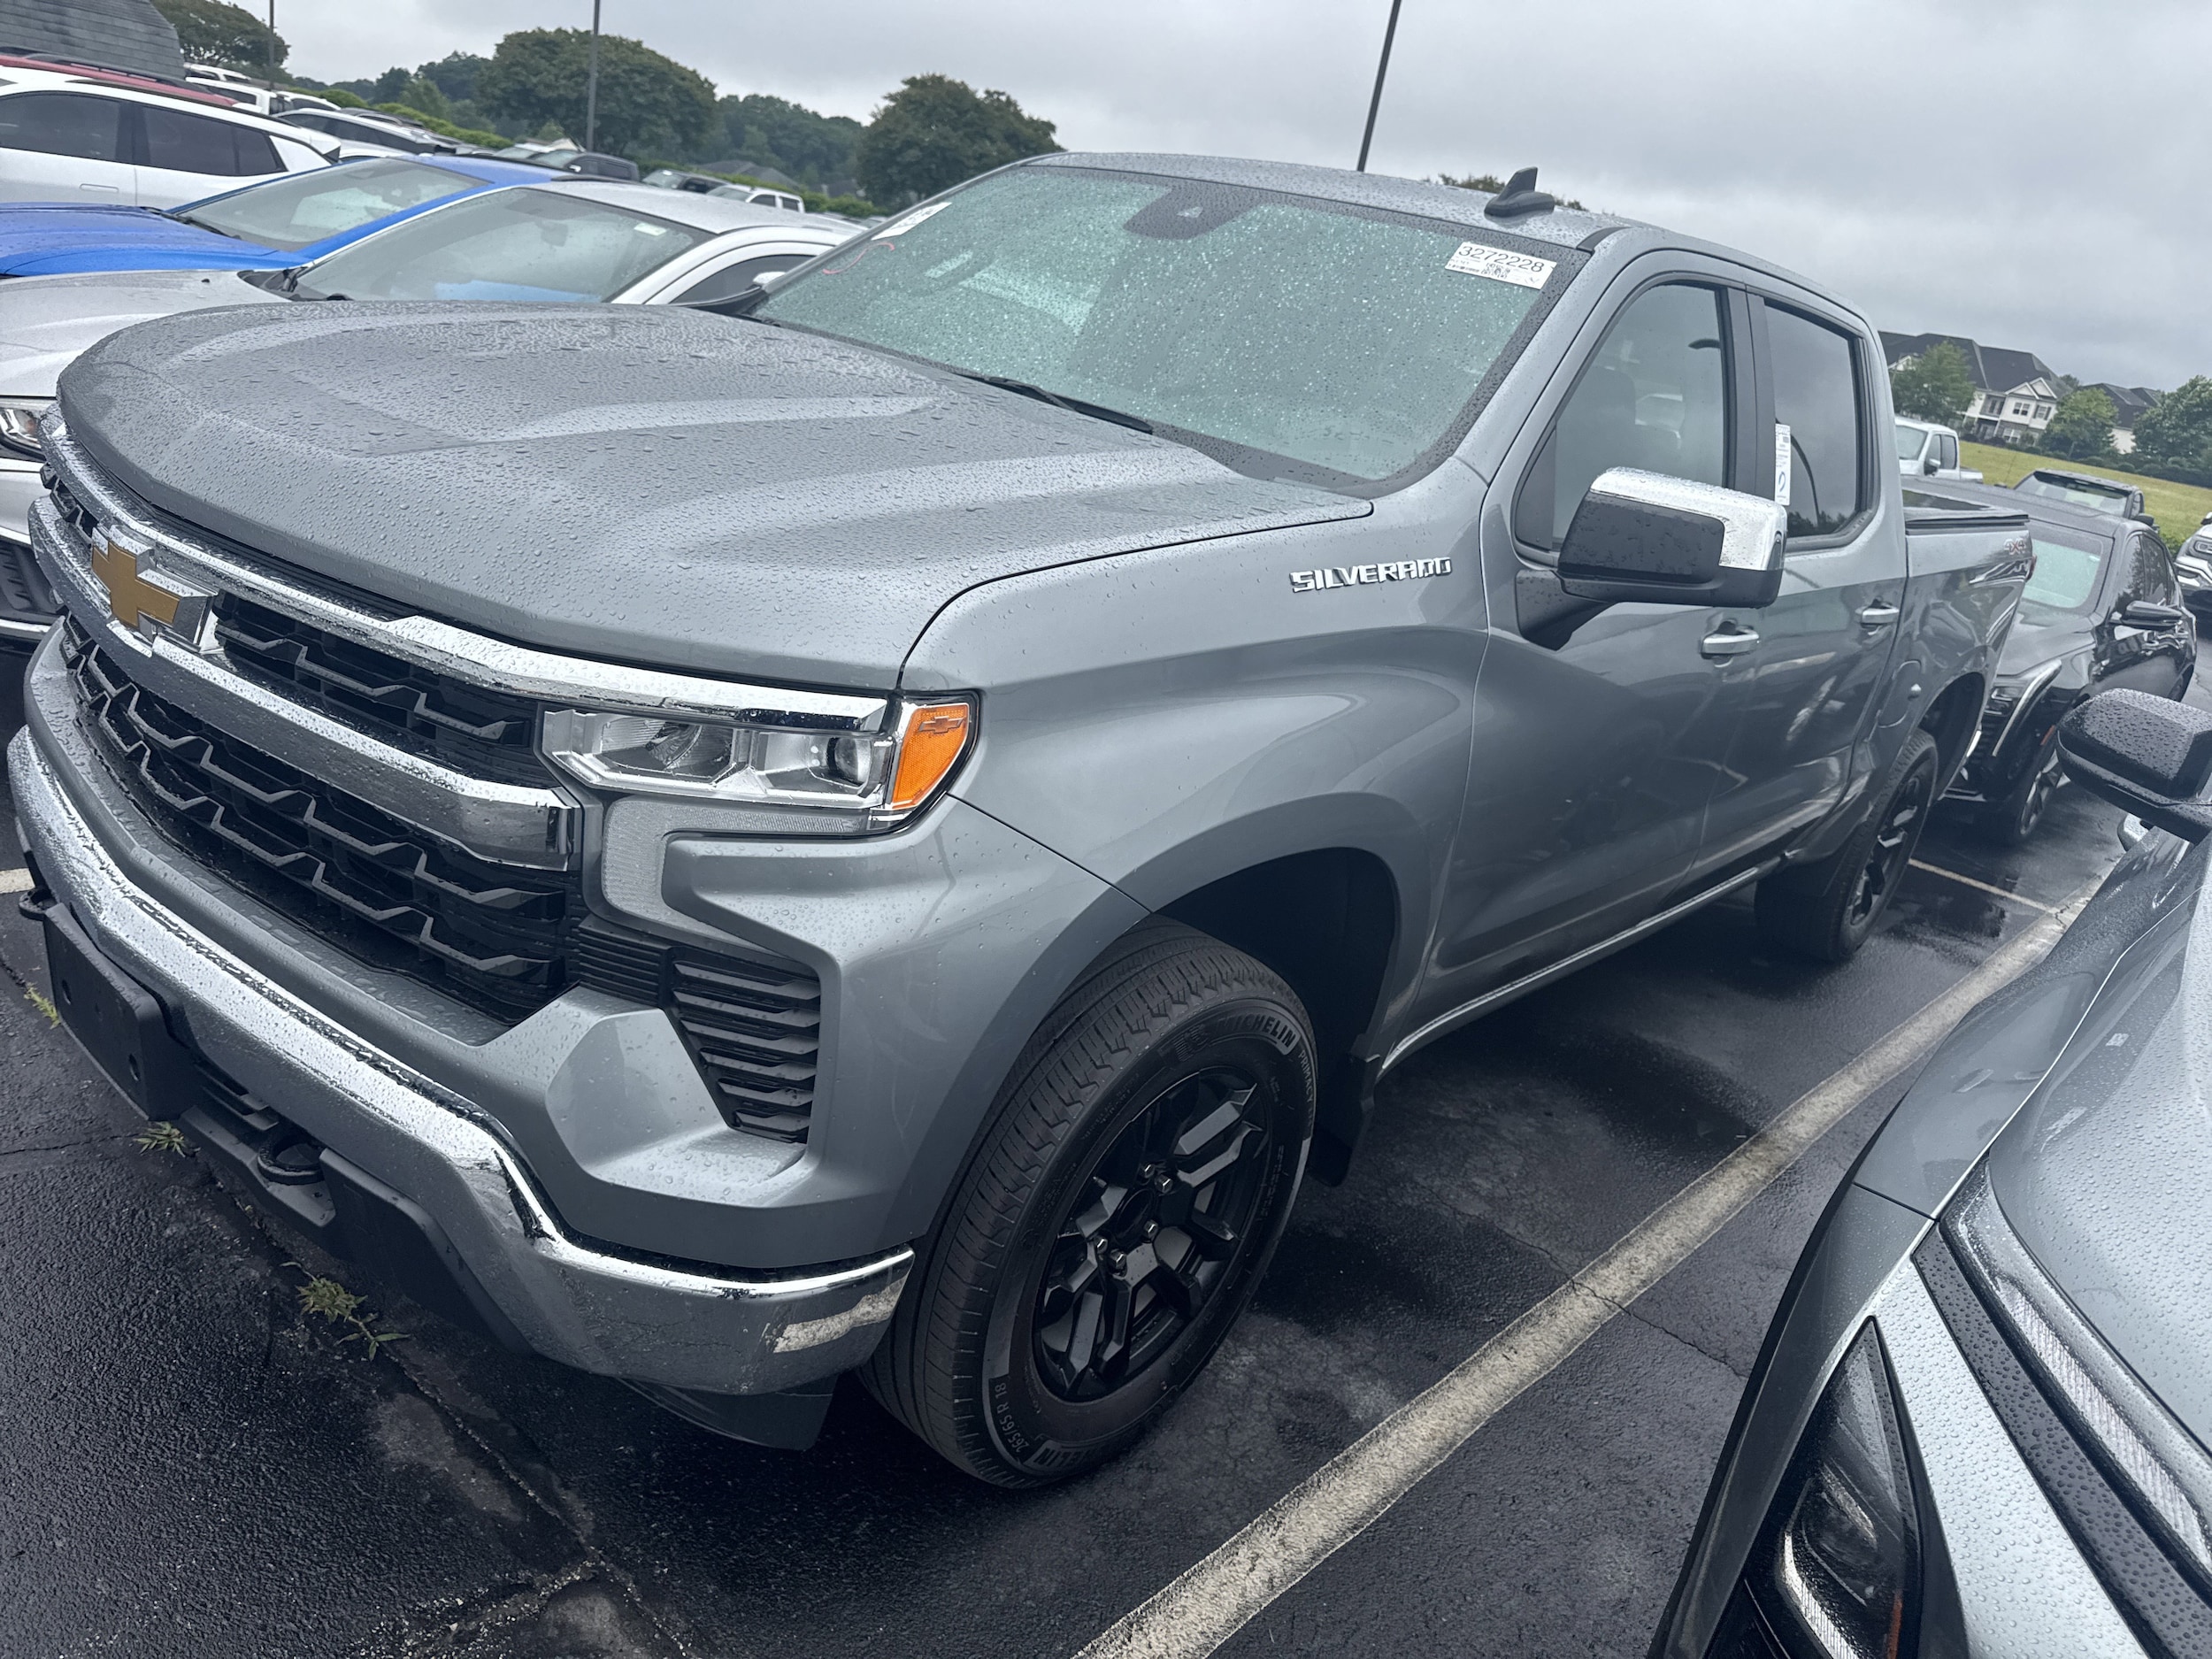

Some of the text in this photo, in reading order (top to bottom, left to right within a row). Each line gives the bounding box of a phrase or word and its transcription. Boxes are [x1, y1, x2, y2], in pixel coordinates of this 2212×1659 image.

[1458, 246, 1545, 273] 3272228
[1289, 557, 1452, 593] SILVERADO
[1217, 1013, 1296, 1048] MICHELIN
[1297, 1049, 1313, 1103] PRIMACY
[995, 1382, 1029, 1453] 265/65 R 18
